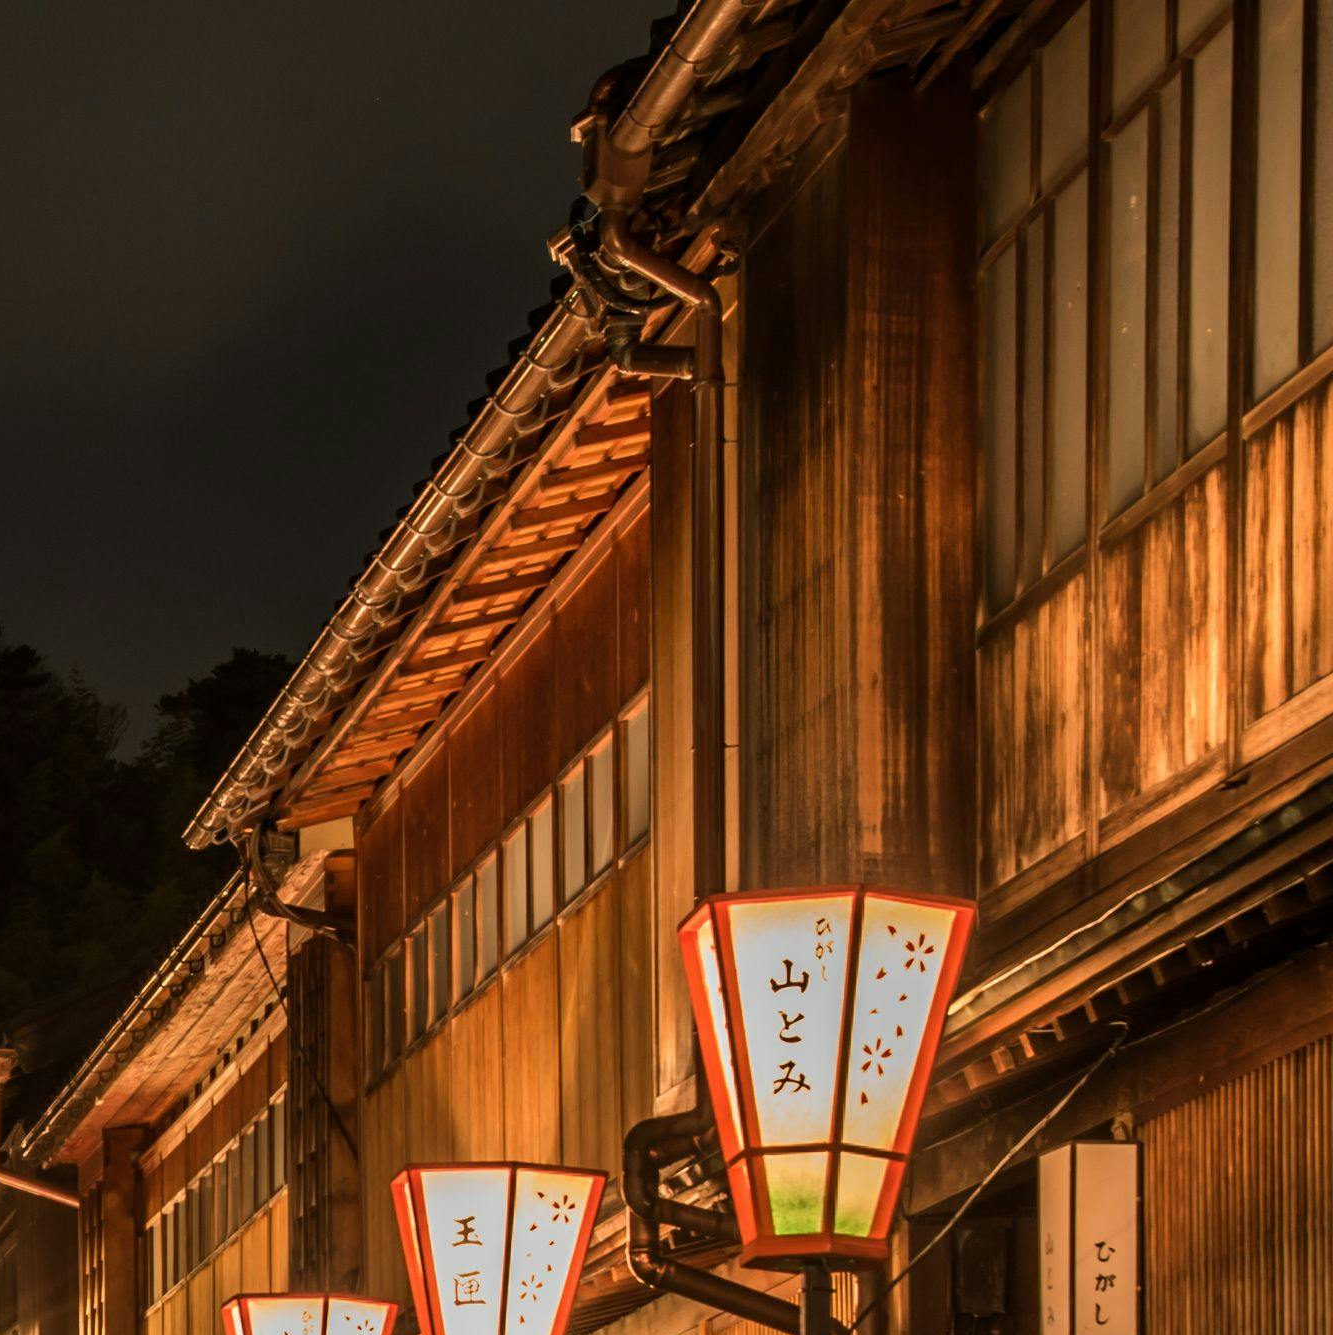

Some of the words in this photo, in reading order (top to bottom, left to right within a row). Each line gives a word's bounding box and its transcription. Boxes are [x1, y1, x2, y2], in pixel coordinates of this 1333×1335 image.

[769, 959, 810, 1094] 山とみ
[1094, 1241, 1116, 1325] ひがし
